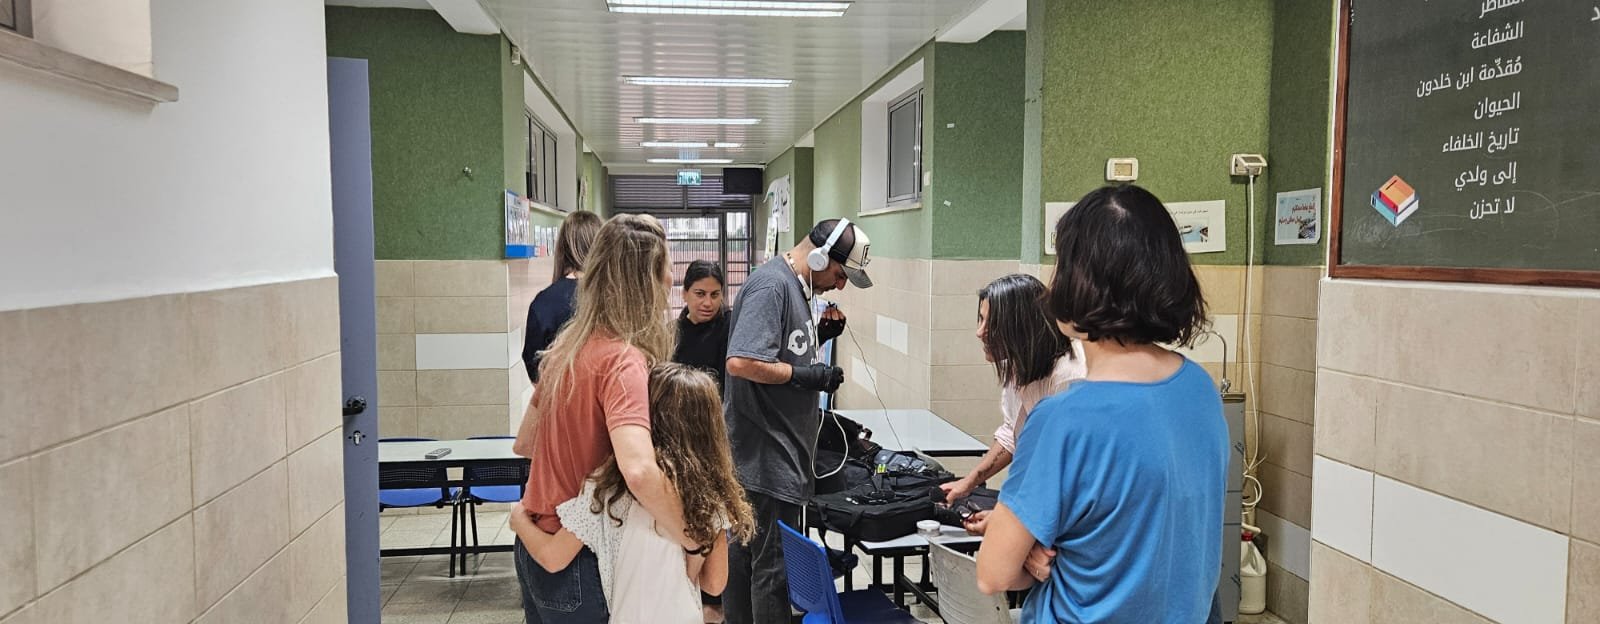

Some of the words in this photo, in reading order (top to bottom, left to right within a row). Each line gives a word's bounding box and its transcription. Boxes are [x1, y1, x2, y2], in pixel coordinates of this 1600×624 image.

[1471, 20, 1524, 50] الشفاعة
[1416, 73, 1452, 98] خلدون
[1456, 66, 1475, 91] ابن
[1474, 91, 1521, 119] الحيوان
[1442, 131, 1484, 153] الخلفاء
[1487, 127, 1520, 153] تاريخ
[1454, 164, 1488, 192] ولدي
[1492, 161, 1517, 185] إلى
[1470, 197, 1501, 220] تحزن
[1503, 196, 1516, 214] لا
